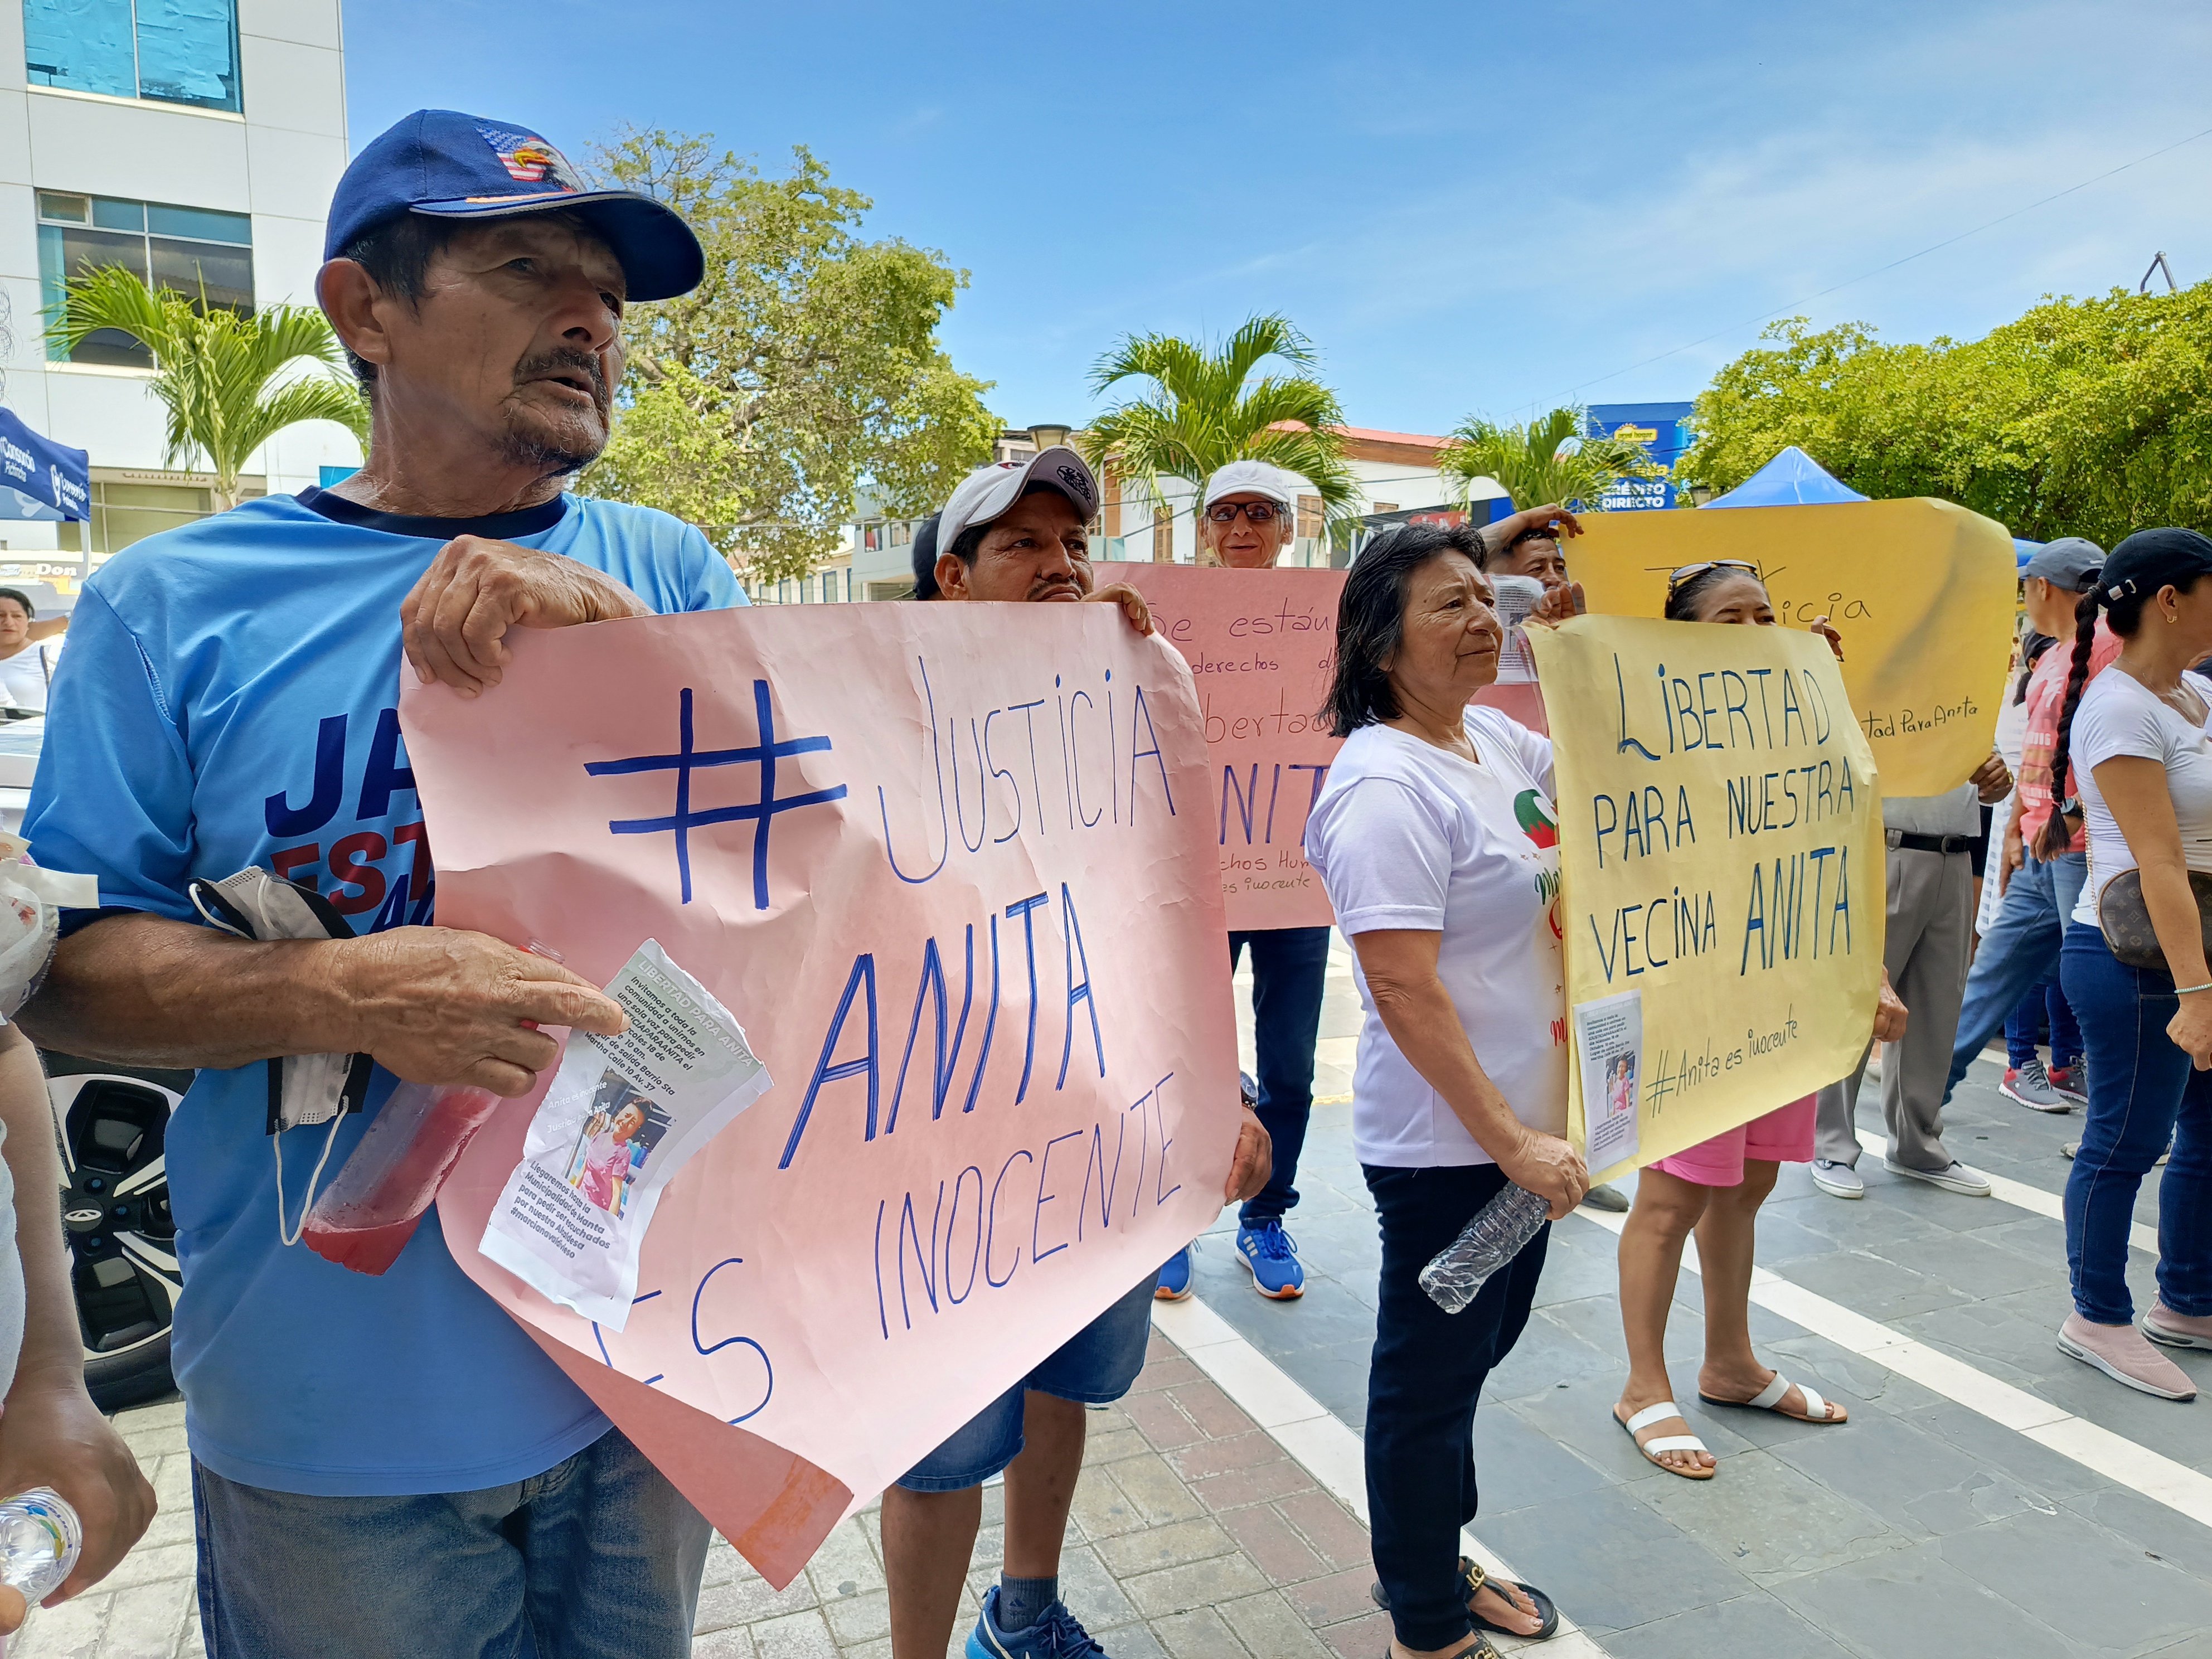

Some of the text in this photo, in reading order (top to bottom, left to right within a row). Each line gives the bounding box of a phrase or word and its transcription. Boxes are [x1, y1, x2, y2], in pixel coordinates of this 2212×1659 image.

[35, 563, 77, 576] Don
[1192, 652, 1279, 675] derechos
[1900, 709, 1931, 733] Para
[584, 680, 847, 910] #
[1594, 756, 1854, 870] PARA NUESTRA
[1740, 846, 1850, 977] ANITA
[617, 992, 696, 1060] una sola voz para pedir
[625, 984, 664, 1021] comunidad
[668, 1024, 696, 1049] unirnos
[695, 1047, 705, 1057] en
[631, 976, 666, 1008] Invitamos
[671, 1012, 693, 1029] toda
[690, 1026, 697, 1036] la
[638, 959, 754, 1068] LIBERTAD PARA ANITA
[777, 881, 1105, 1169] ANITA
[585, 1031, 609, 1054] Martha
[608, 1052, 625, 1069] Calle
[625, 1066, 634, 1076] 10
[632, 1073, 643, 1085] Av.
[644, 1081, 656, 1092] 37
[609, 1041, 619, 1050] de
[619, 1048, 641, 1068] salida
[639, 1065, 662, 1085] Barrio
[661, 1083, 675, 1096] Sta
[625, 1039, 646, 1060] 10 am.
[647, 1044, 656, 1052] 18
[654, 1050, 666, 1061] de
[1645, 1037, 1720, 1118] #Anita
[1725, 1048, 1743, 1070] es
[547, 1097, 571, 1110] Anita
[579, 1080, 608, 1099] inocente
[547, 1117, 577, 1133] Justicia
[593, 1101, 610, 1115] Anita
[518, 1183, 610, 1249] para pedir ser escuchados
[525, 1172, 605, 1234] Municipalidad de Manta
[530, 1160, 591, 1214] Llegaremos hasta la
[875, 1071, 1181, 1340] INOCENTE
[510, 1206, 575, 1259] #marcianavaldivieso
[514, 1195, 585, 1250] por nuestra Alcaldesa
